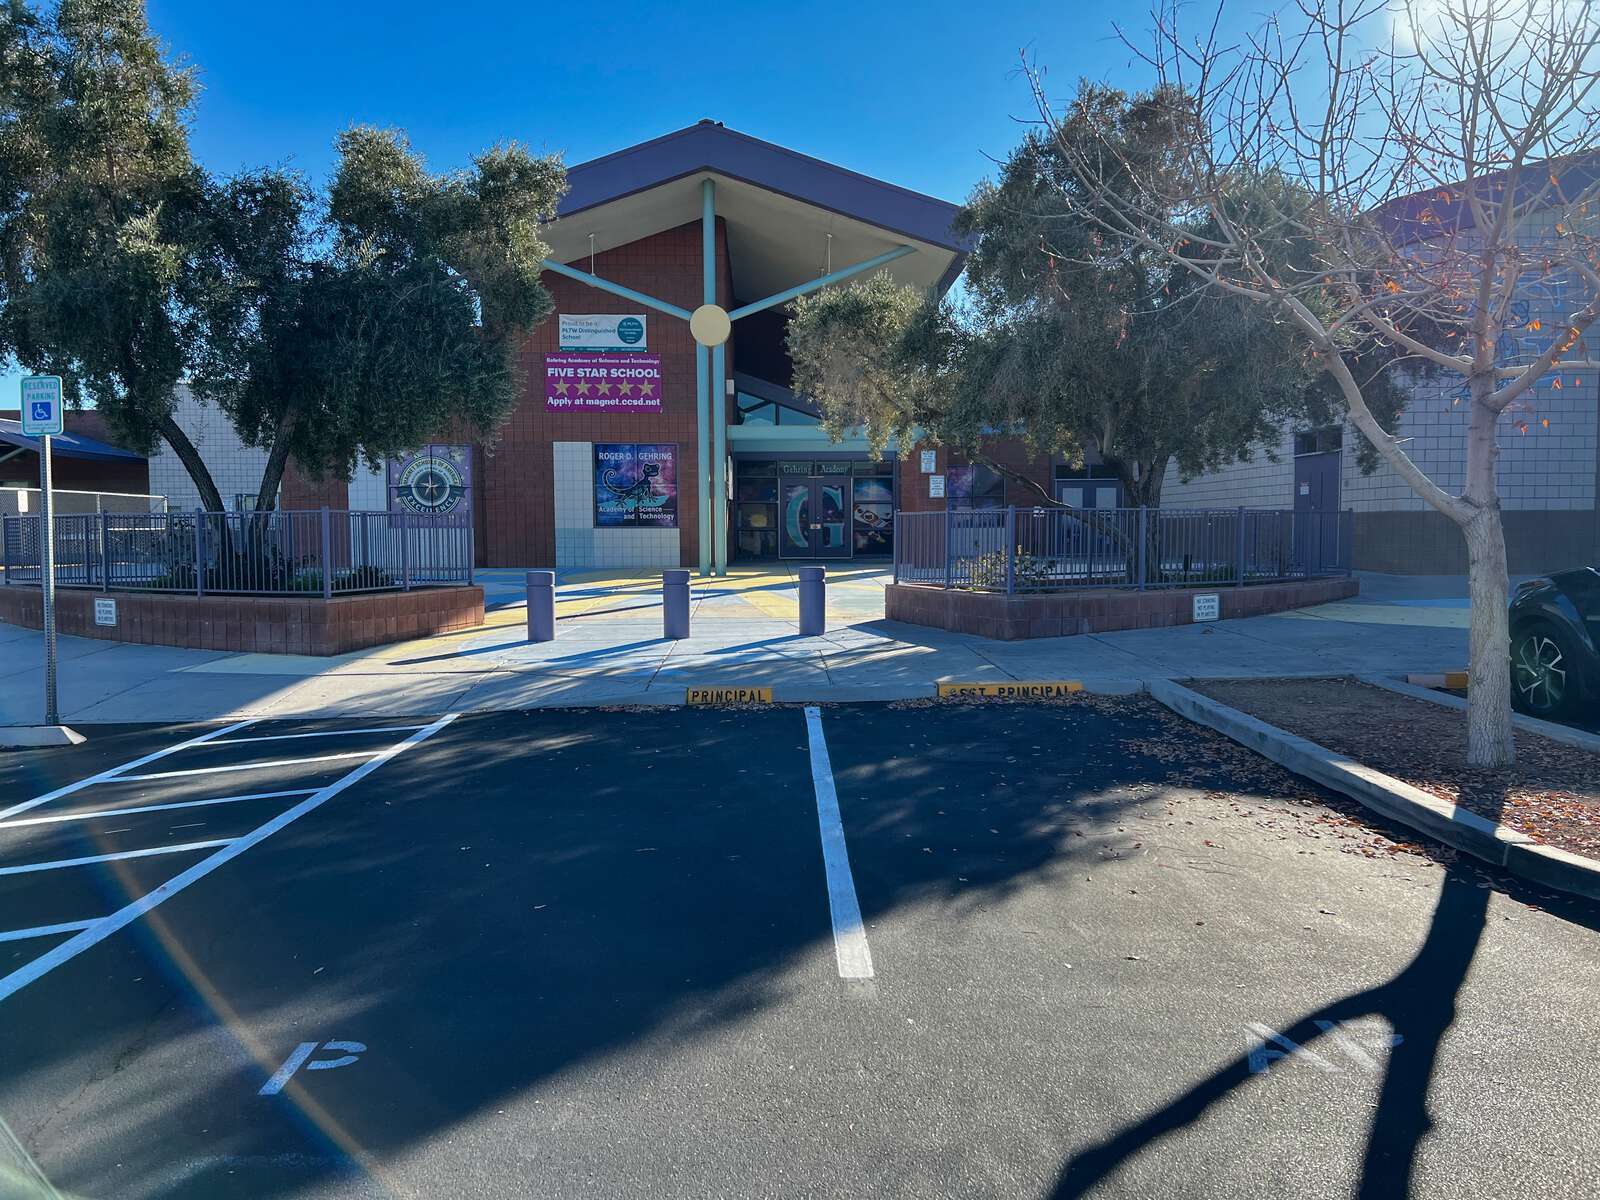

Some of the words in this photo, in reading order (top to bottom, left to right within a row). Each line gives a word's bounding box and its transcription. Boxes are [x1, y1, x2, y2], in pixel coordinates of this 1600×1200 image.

[548, 368, 574, 377] FIVE
[577, 368, 607, 377] STAR
[610, 368, 660, 377] SCHOOL
[24, 382, 57, 390] RESERVED
[27, 392, 56, 400] PARKING
[548, 397, 572, 406] Apply
[586, 398, 660, 406] magnet.ccsd.net
[407, 496, 454, 512] EXCELLENCE
[692, 690, 766, 704] PRINCIPAL
[998, 686, 1068, 698] PRINCIPAL
[257, 1040, 368, 1096] P
